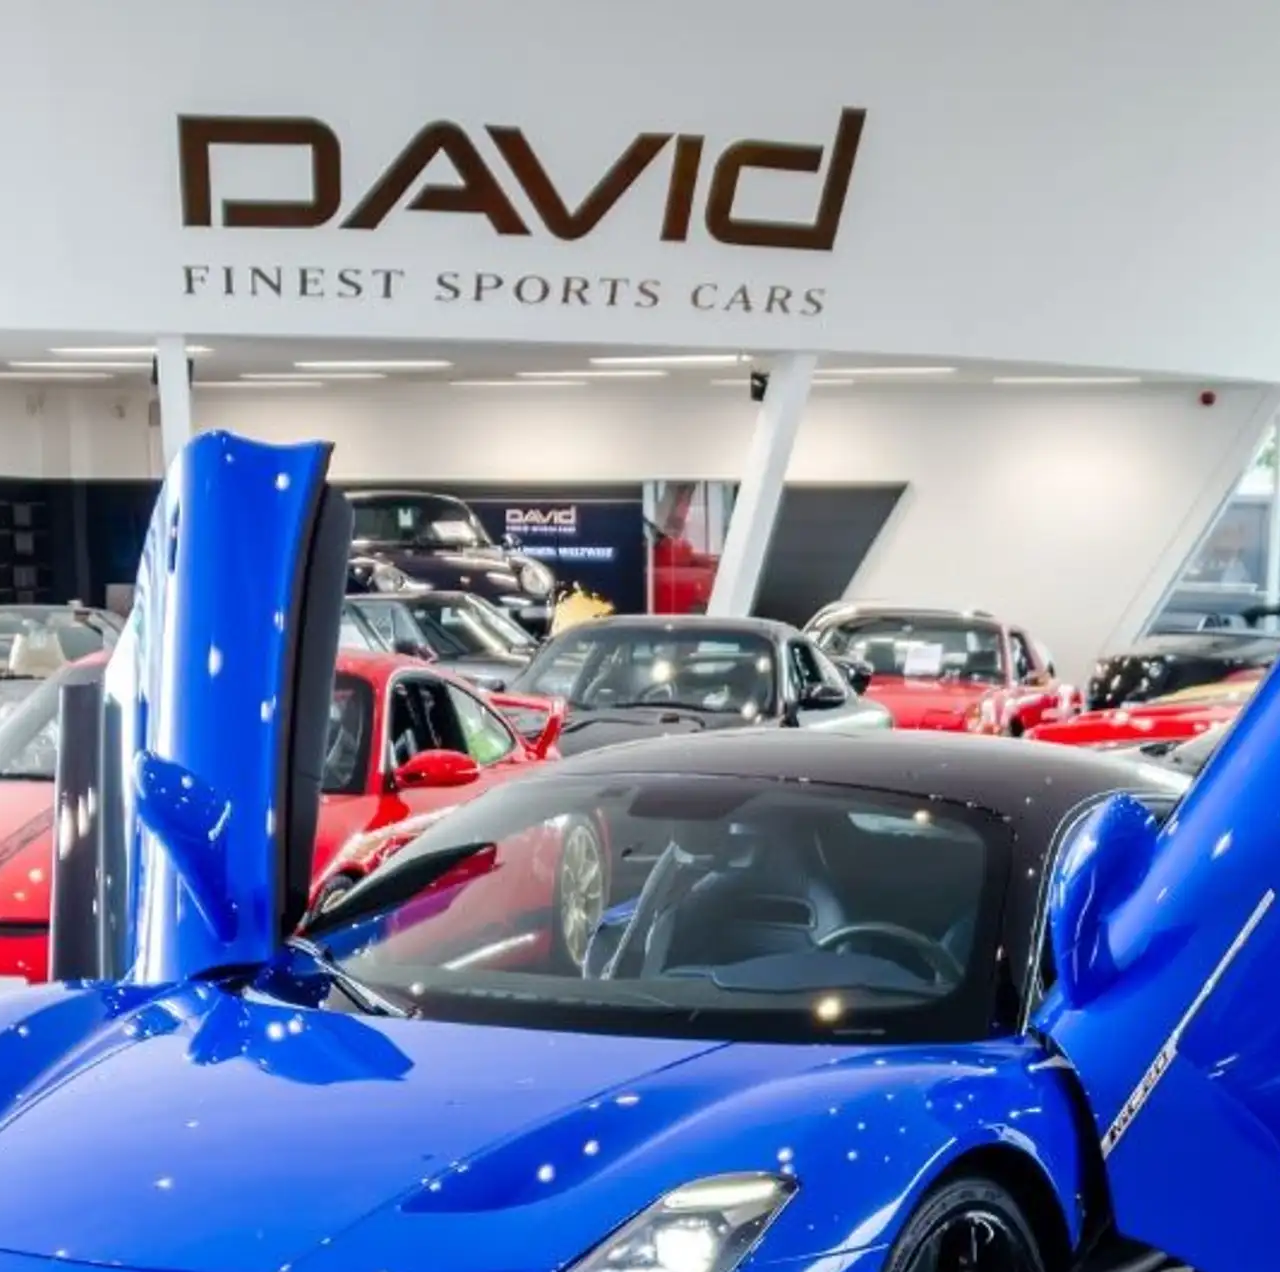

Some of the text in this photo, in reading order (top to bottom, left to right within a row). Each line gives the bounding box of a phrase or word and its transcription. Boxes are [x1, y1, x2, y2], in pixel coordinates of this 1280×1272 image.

[182, 265, 827, 317] FINEST SPORTS CARS
